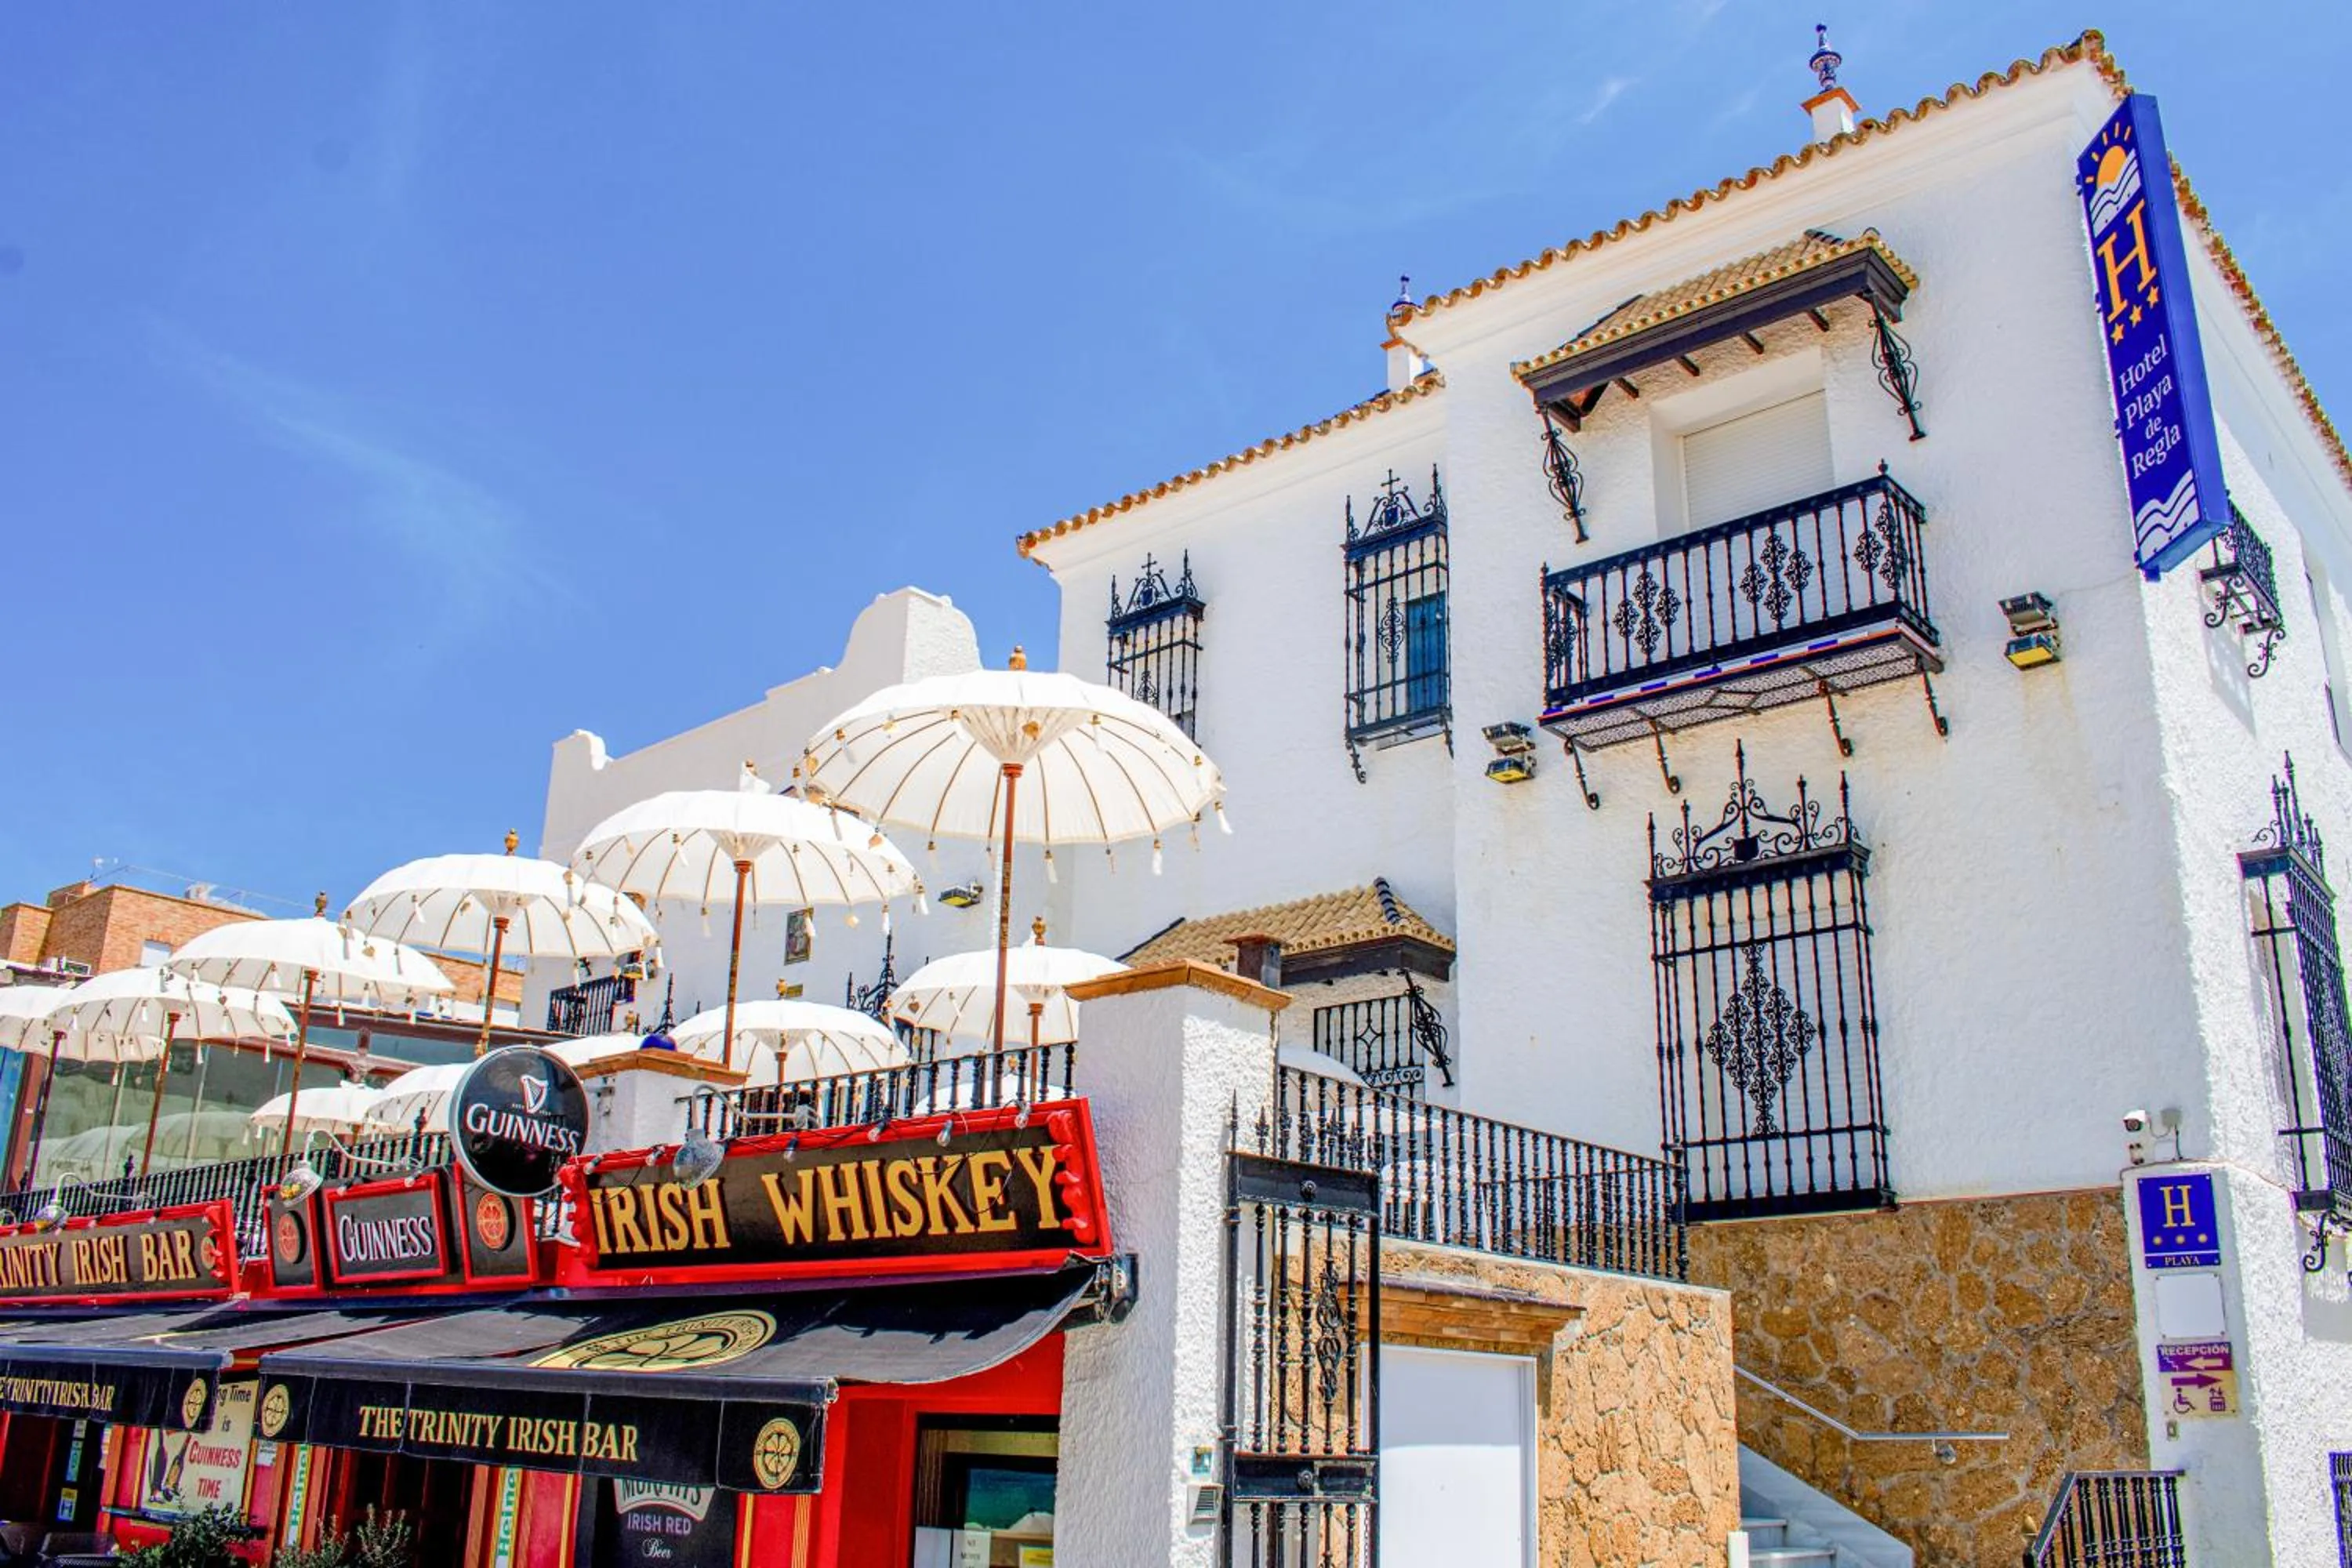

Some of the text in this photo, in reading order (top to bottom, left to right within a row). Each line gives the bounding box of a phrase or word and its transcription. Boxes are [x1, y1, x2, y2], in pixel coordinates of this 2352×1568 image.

[2097, 199, 2157, 323] H
[2119, 333, 2169, 397] Hotel
[2125, 374, 2172, 430] Playa
[2130, 424, 2182, 479] Regla
[2145, 416, 2162, 440] de
[466, 1103, 580, 1153] GUINNESS
[591, 1145, 1062, 1254] IRISH WHISKEY
[2159, 1185, 2195, 1228] H
[72, 1235, 129, 1284] IRISH
[140, 1230, 196, 1281] BAR
[338, 1214, 433, 1262] GUINNESS
[2164, 1256, 2200, 1266] PLAYA
[52, 1381, 91, 1408] IRISH
[91, 1383, 115, 1411] BAR
[222, 1414, 231, 1432] is
[359, 1406, 638, 1461] THE TRINITY IRISH BAR
[187, 1441, 242, 1468] GUINNESS
[198, 1478, 223, 1499] TIME
[627, 1512, 691, 1536] IRISH RED
